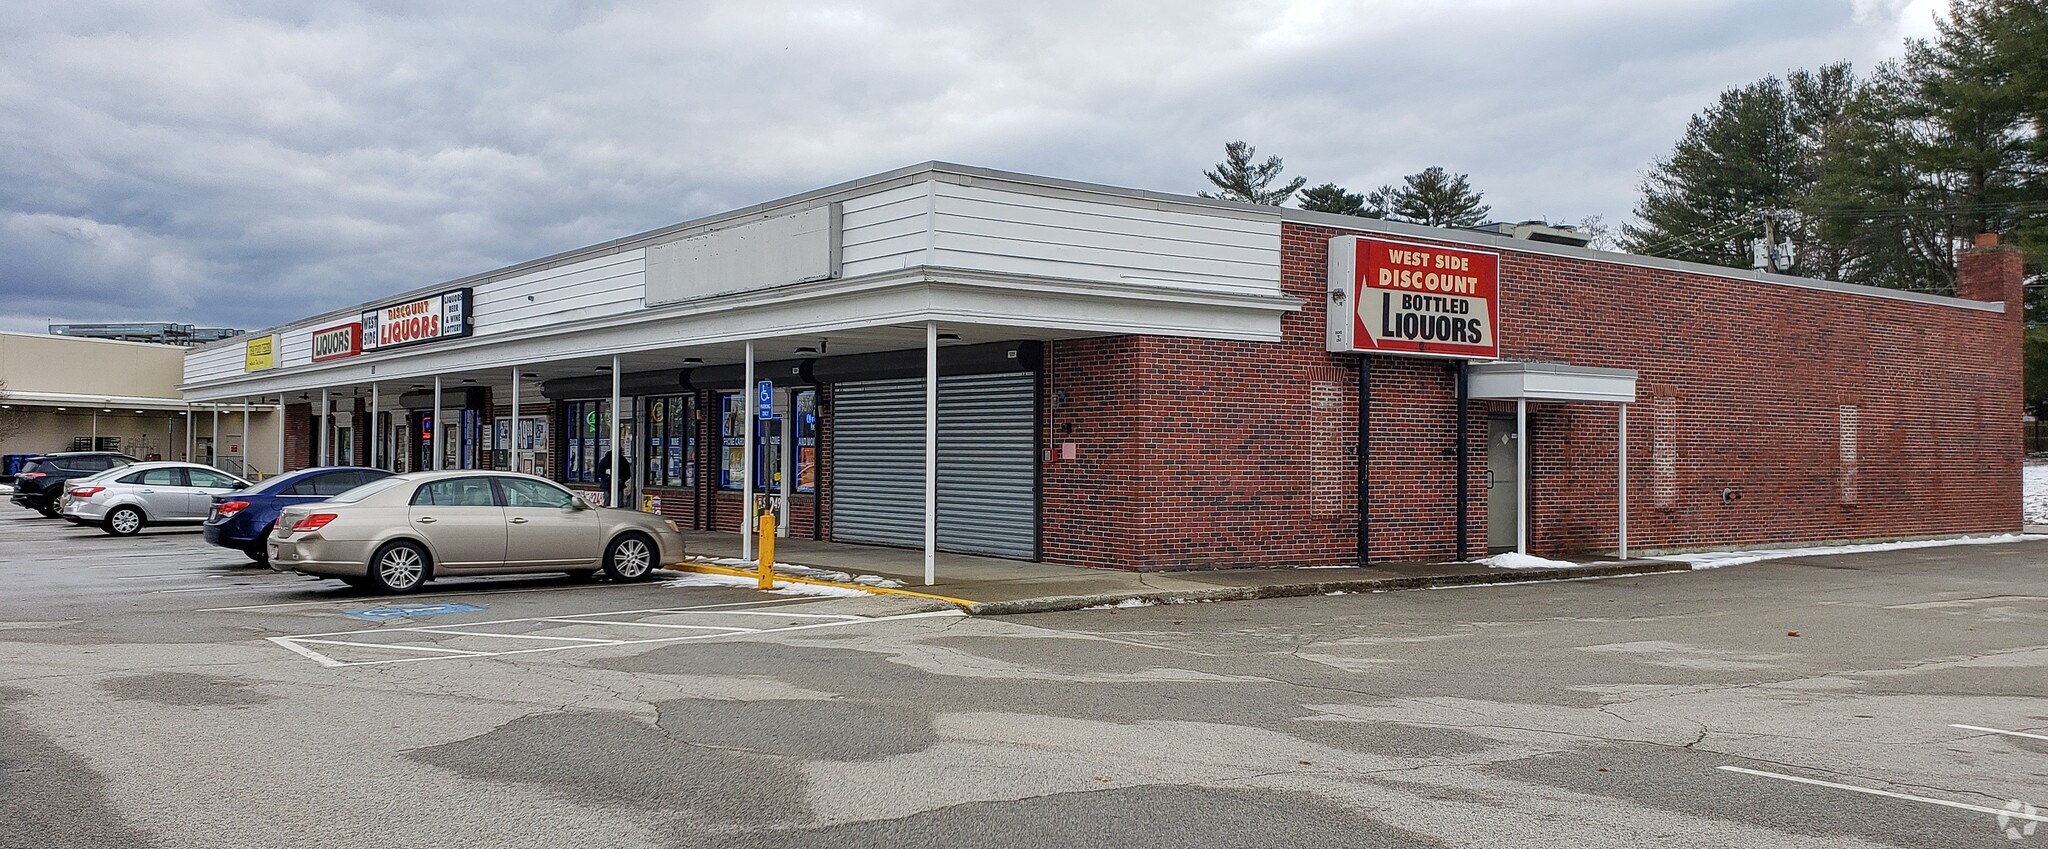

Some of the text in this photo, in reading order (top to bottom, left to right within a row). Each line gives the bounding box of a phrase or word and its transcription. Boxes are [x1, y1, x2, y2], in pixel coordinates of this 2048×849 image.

[1389, 249, 1469, 272] WEST SIDE
[1379, 268, 1478, 294] DISCOUNT
[444, 292, 463, 304] LIQUORS
[1402, 293, 1469, 314] BOTTLED
[388, 300, 430, 321] DISCOUNT
[448, 304, 459, 314] BEER
[450, 313, 461, 324] WINE
[1382, 292, 1482, 344] LIQUORS
[363, 315, 377, 330] WEST
[381, 314, 439, 345] LIQUORS
[444, 324, 461, 334] LOTTERY
[316, 329, 349, 357] LIQUORS
[364, 331, 376, 346] SIDE
